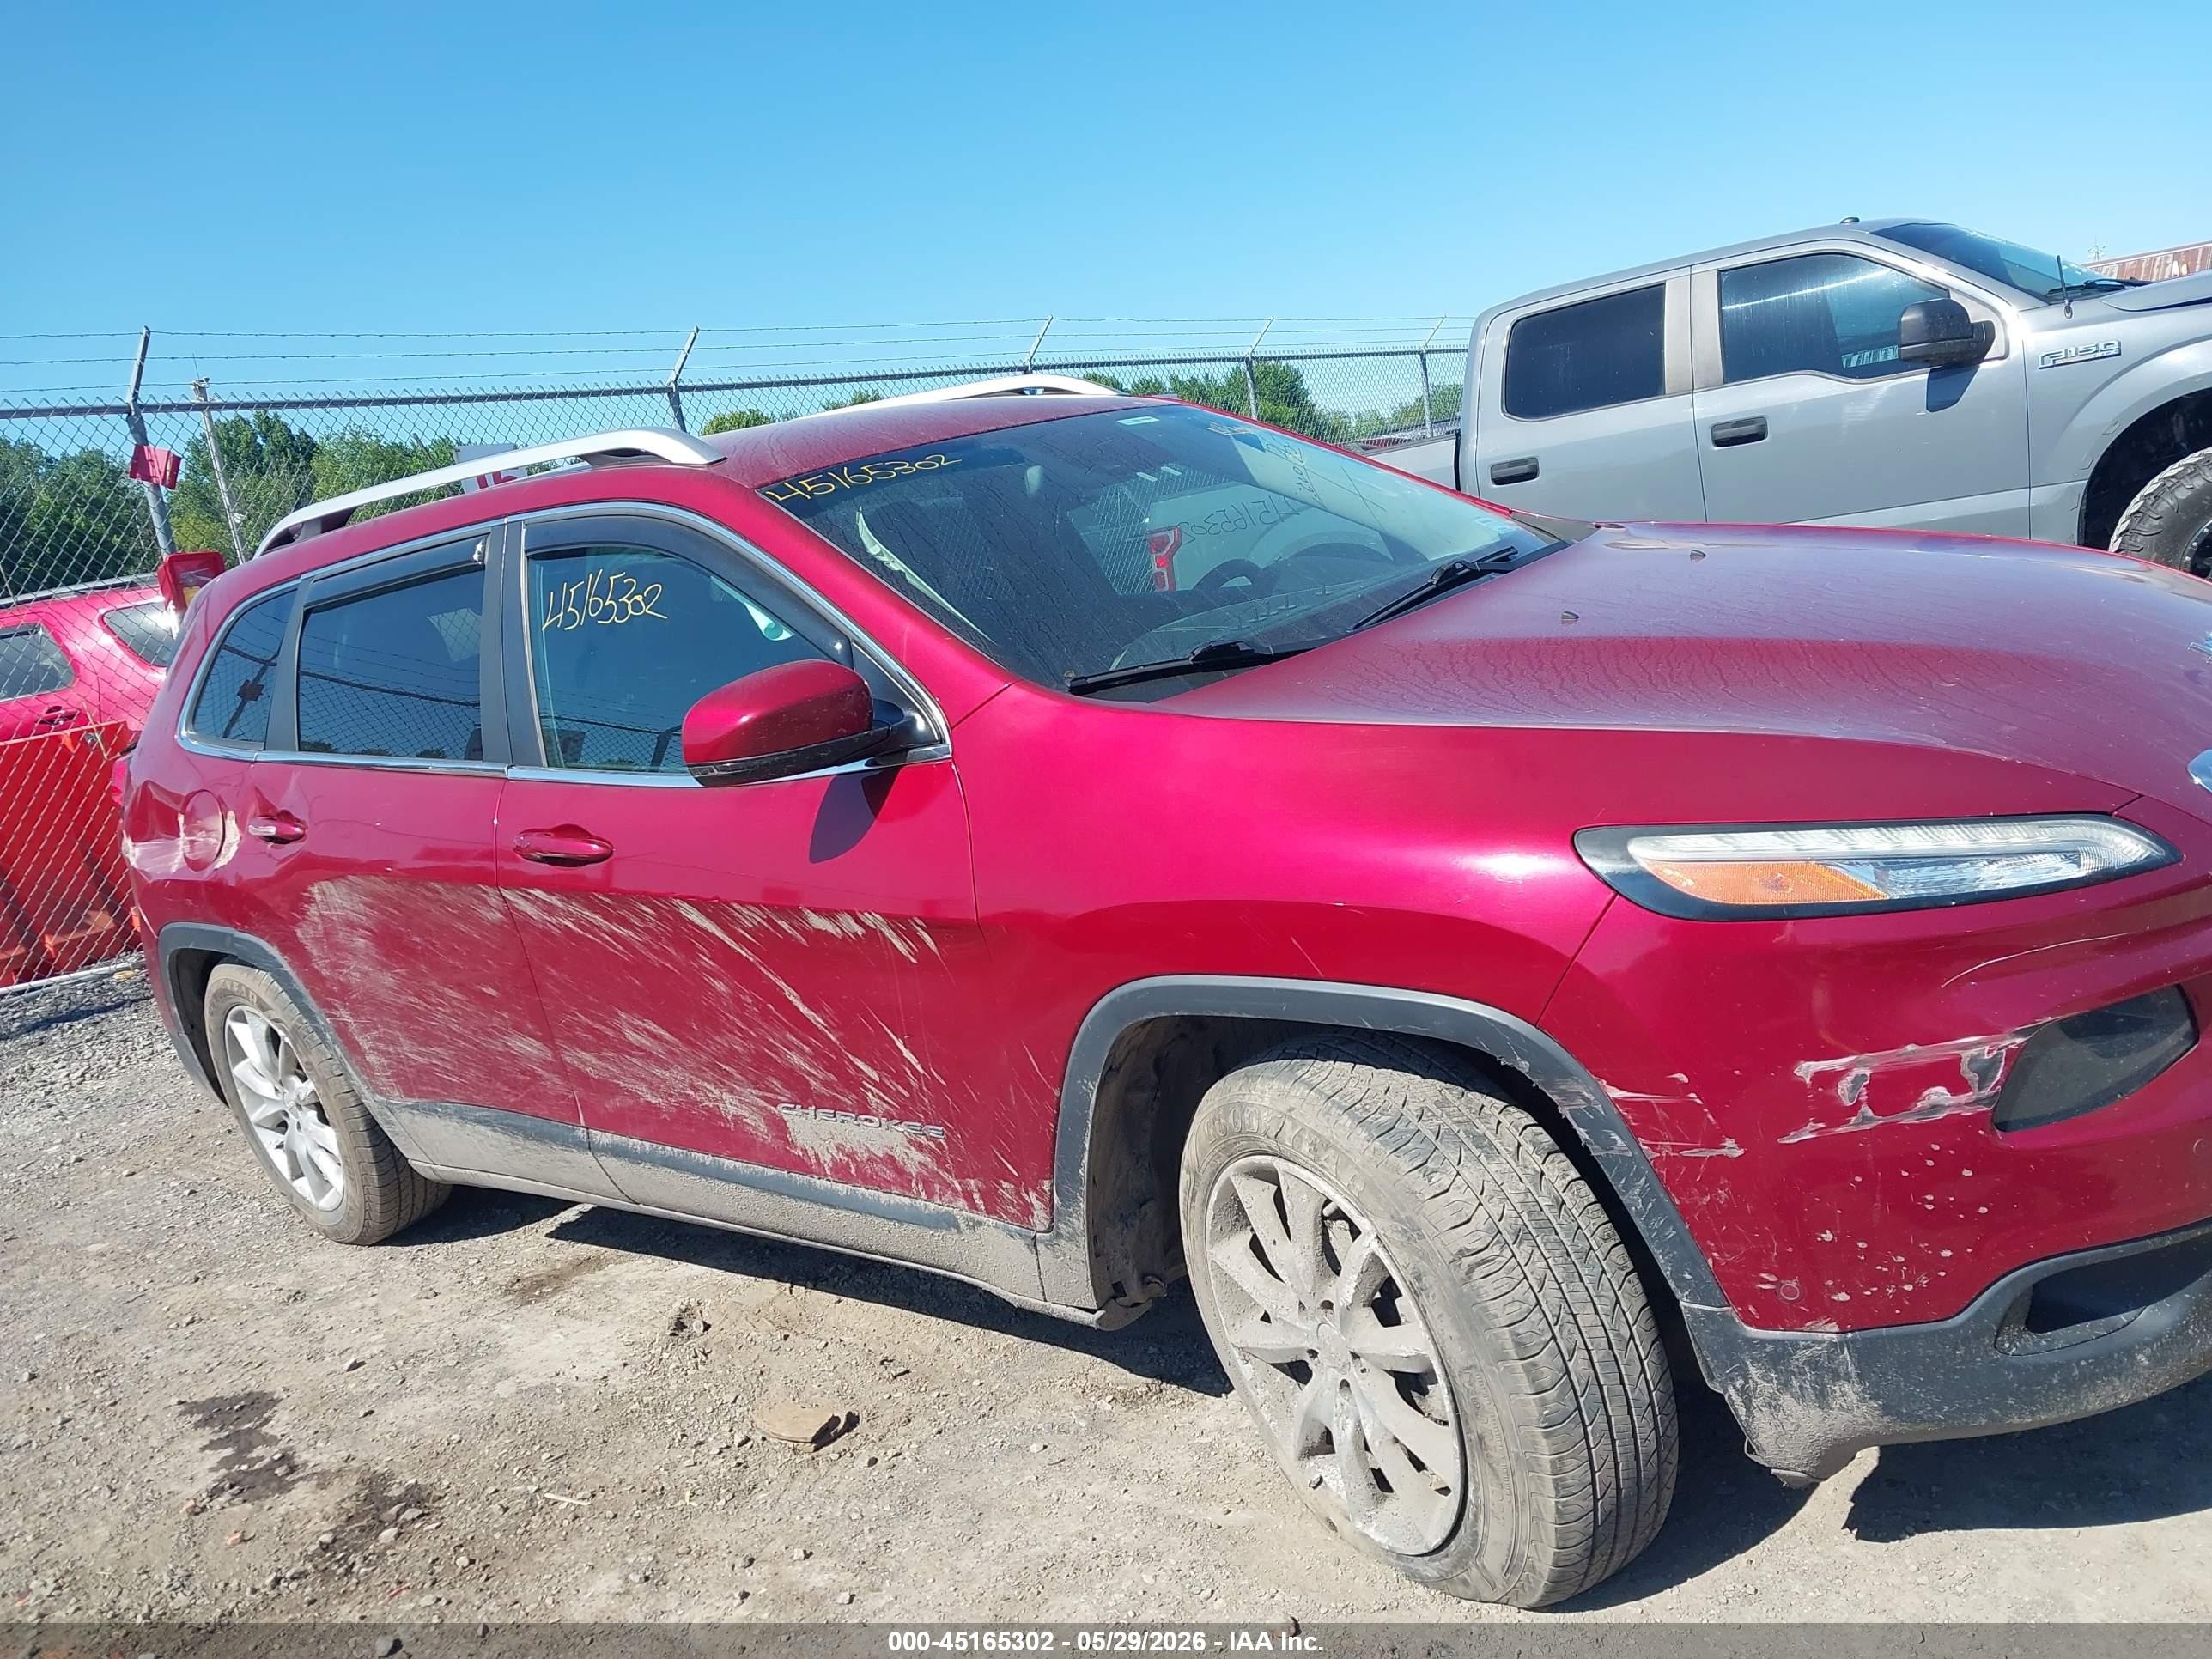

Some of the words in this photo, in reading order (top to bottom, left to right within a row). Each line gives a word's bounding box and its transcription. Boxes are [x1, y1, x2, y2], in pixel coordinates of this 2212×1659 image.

[766, 454, 962, 501] 45165302
[542, 568, 668, 631] 45165302
[777, 1103, 945, 1139] CHEROKEE
